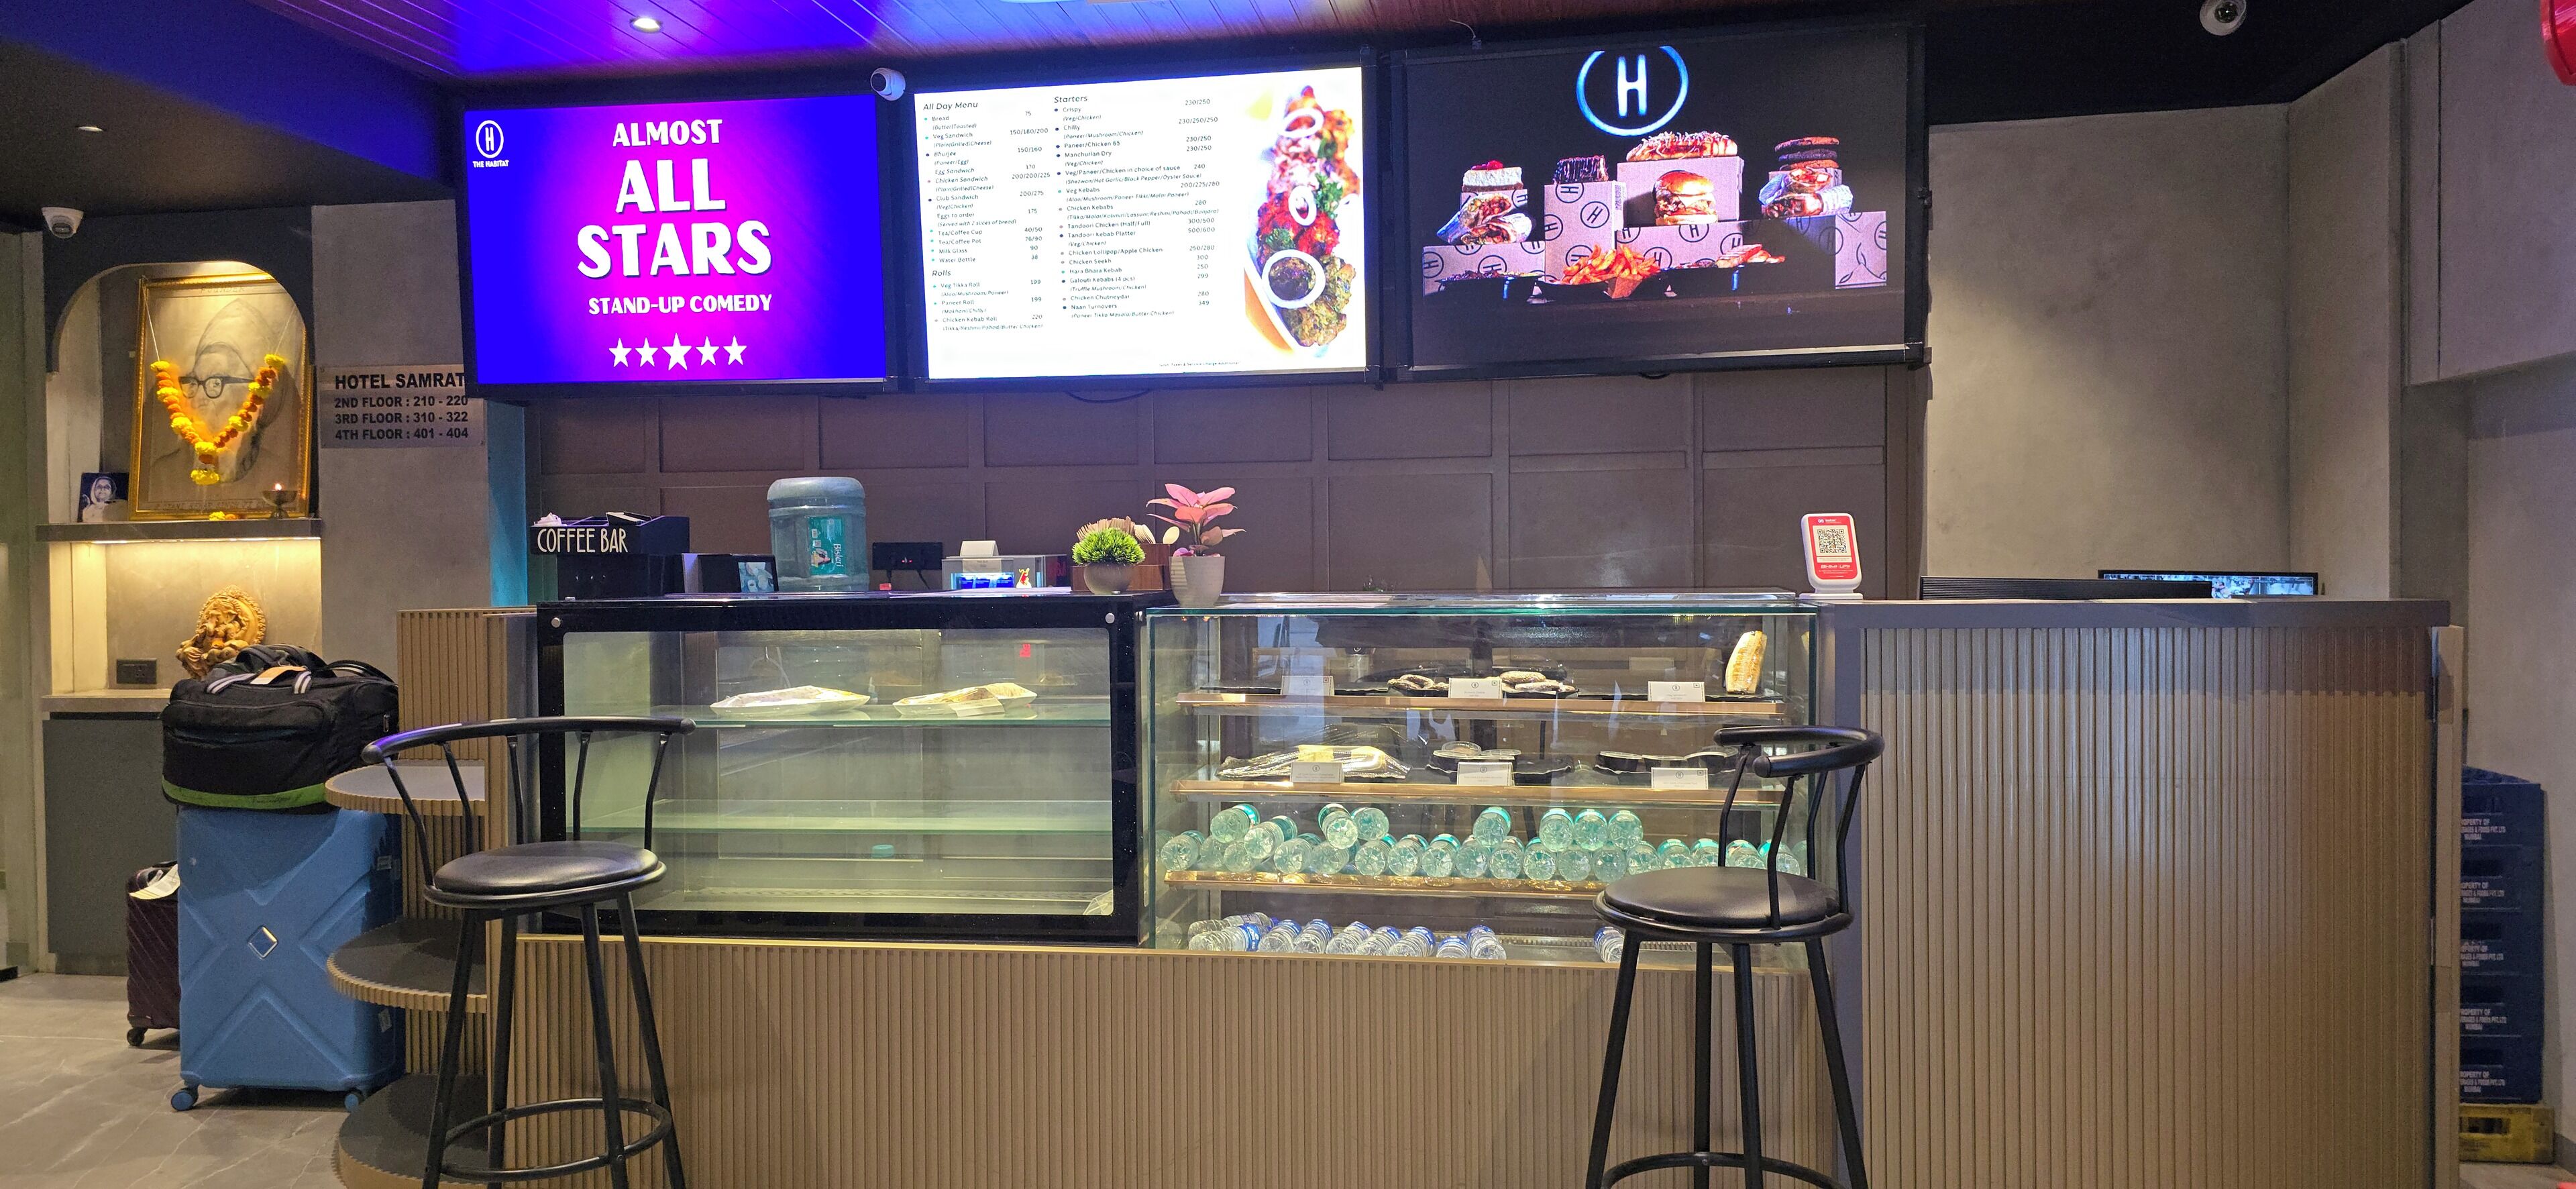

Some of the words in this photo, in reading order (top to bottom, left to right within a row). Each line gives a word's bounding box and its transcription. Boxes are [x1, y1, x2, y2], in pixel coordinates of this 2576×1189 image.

[1617, 54, 1648, 117] H
[935, 103, 953, 111] Day
[1178, 116, 1218, 124] 230/250/250
[485, 127, 494, 151] H
[612, 119, 723, 147] ALMOST
[485, 159, 509, 168] HABITAT
[1065, 168, 1126, 176] Veg/Paneer/Chicken
[615, 158, 727, 213] ALL
[577, 219, 772, 278] STARS
[588, 296, 686, 315] STAND-UP
[690, 293, 773, 313] COMEDY
[335, 373, 390, 389] HOTEL
[396, 372, 464, 389] SAMRAT
[334, 397, 358, 408] 2ND
[362, 397, 402, 407] FLOOR
[413, 396, 435, 407] 210
[446, 395, 468, 407] 220
[335, 413, 358, 424] 3RD
[362, 413, 402, 423] FLOOR
[413, 412, 435, 423] 310
[446, 411, 468, 422] 322
[335, 429, 358, 440] 4TH
[362, 429, 402, 440] FLOOR
[414, 428, 435, 439] 401
[447, 427, 469, 438] 404
[537, 527, 595, 553] COFFEE
[600, 527, 628, 553] BAR
[833, 544, 844, 567] Bisleri
